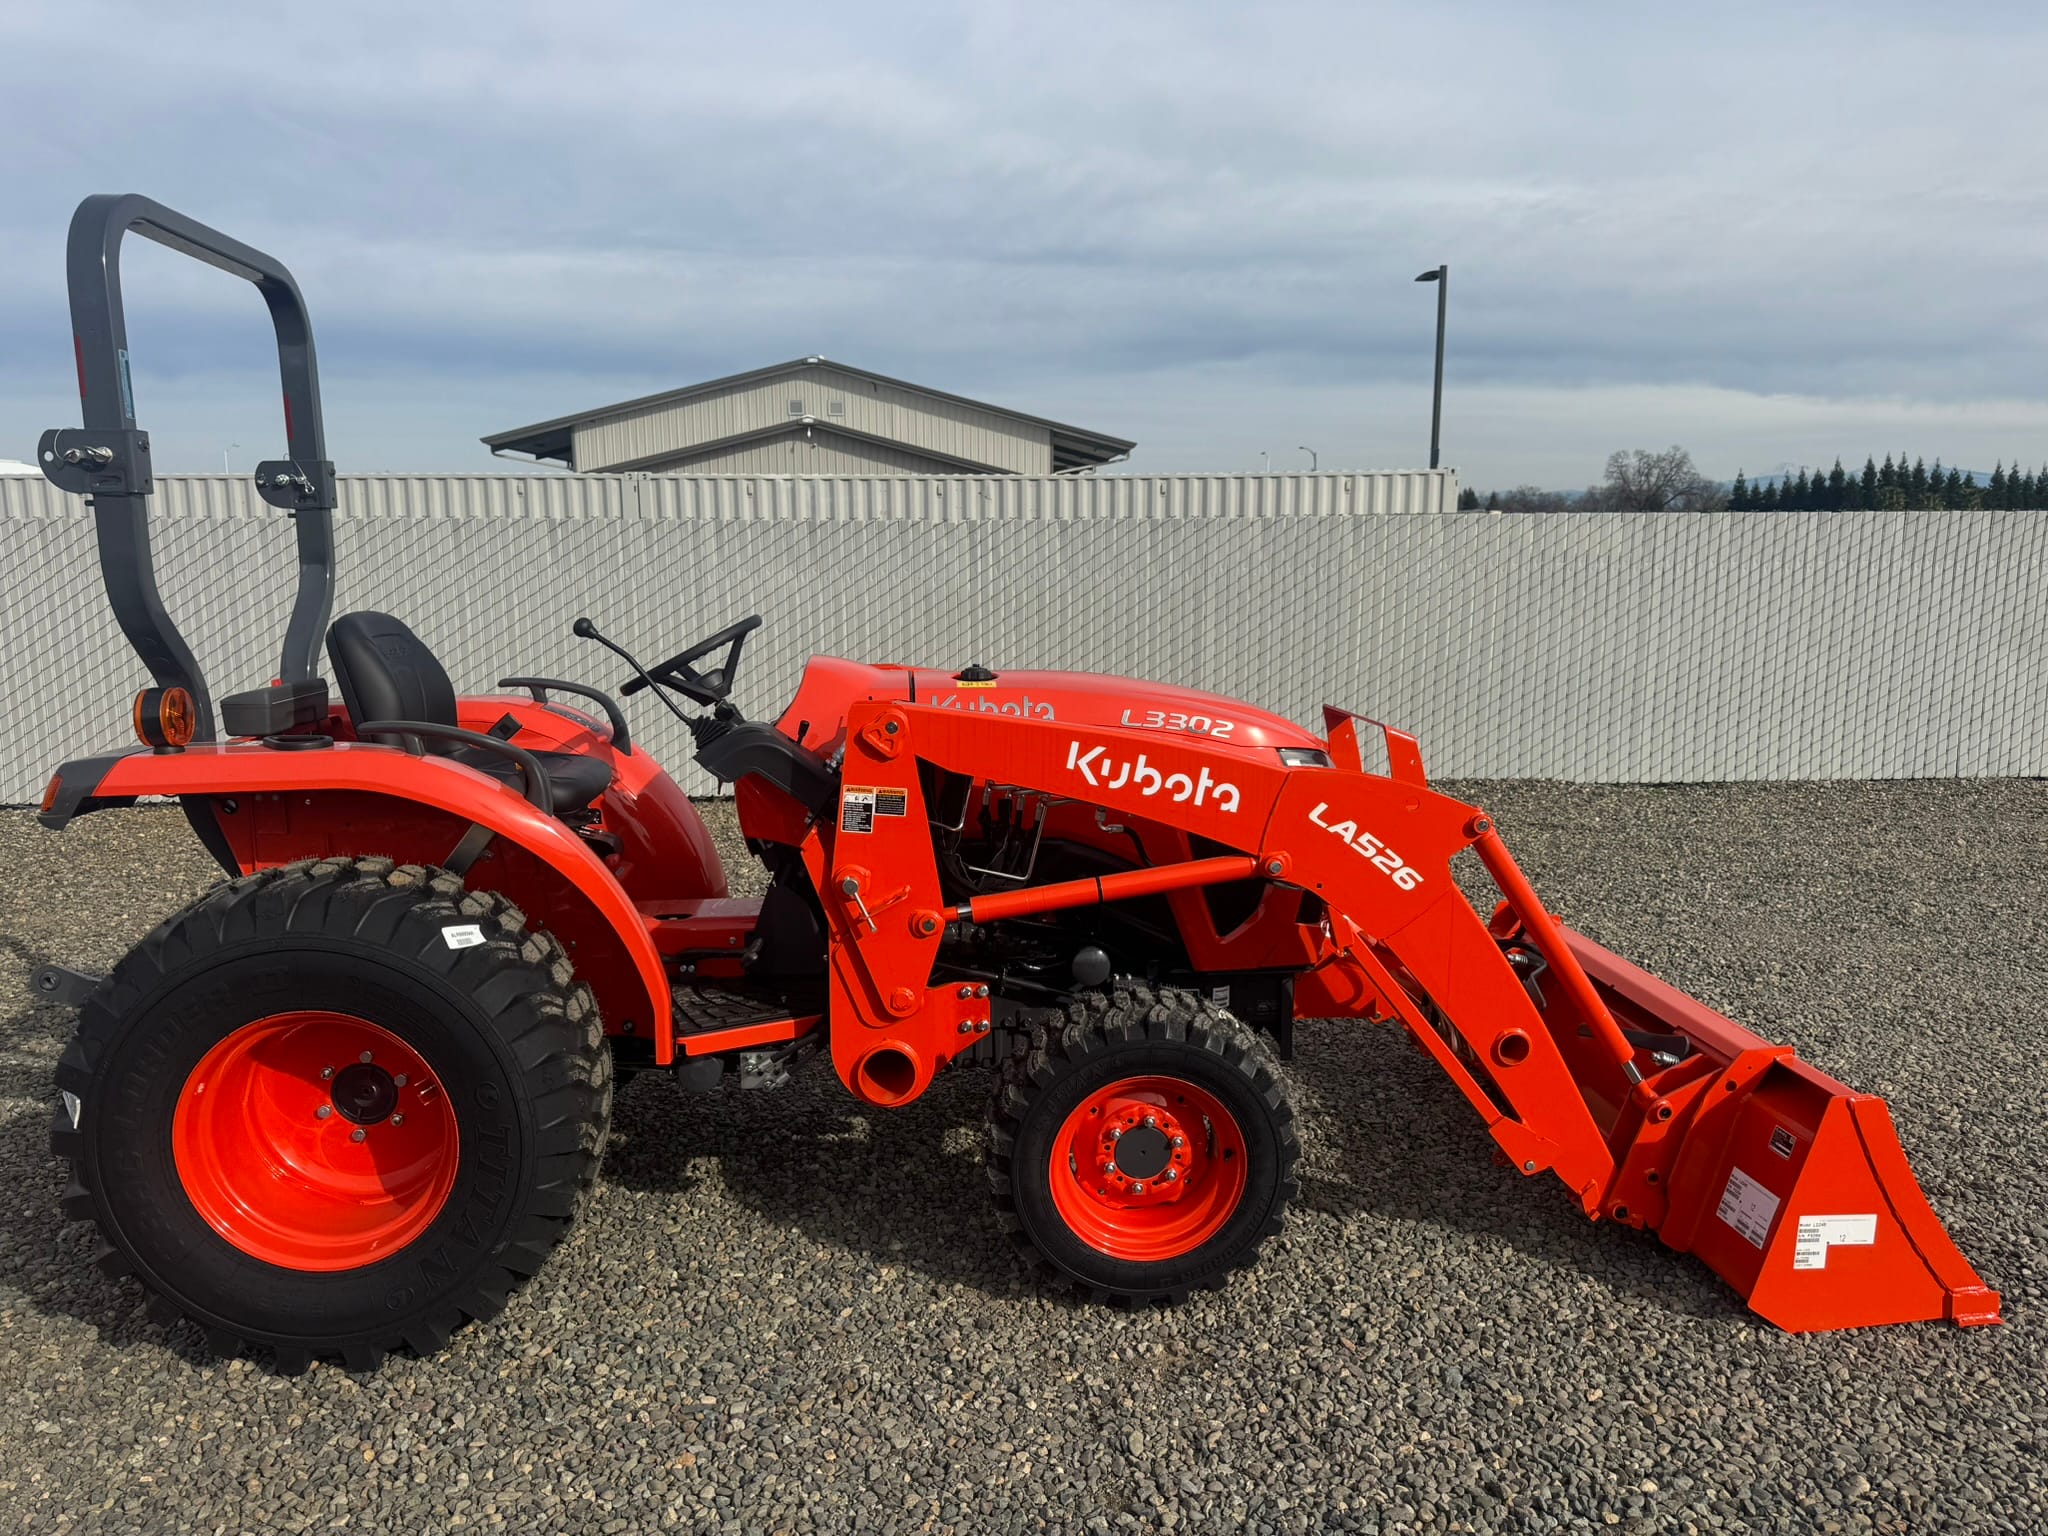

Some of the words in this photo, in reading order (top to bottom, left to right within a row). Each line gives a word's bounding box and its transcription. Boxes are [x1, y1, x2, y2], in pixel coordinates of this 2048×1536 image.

[1120, 708, 1235, 739] L3302
[1065, 740, 1241, 813] Kubota
[1308, 802, 1424, 891] LA526
[416, 1123, 513, 1295] TITAN
